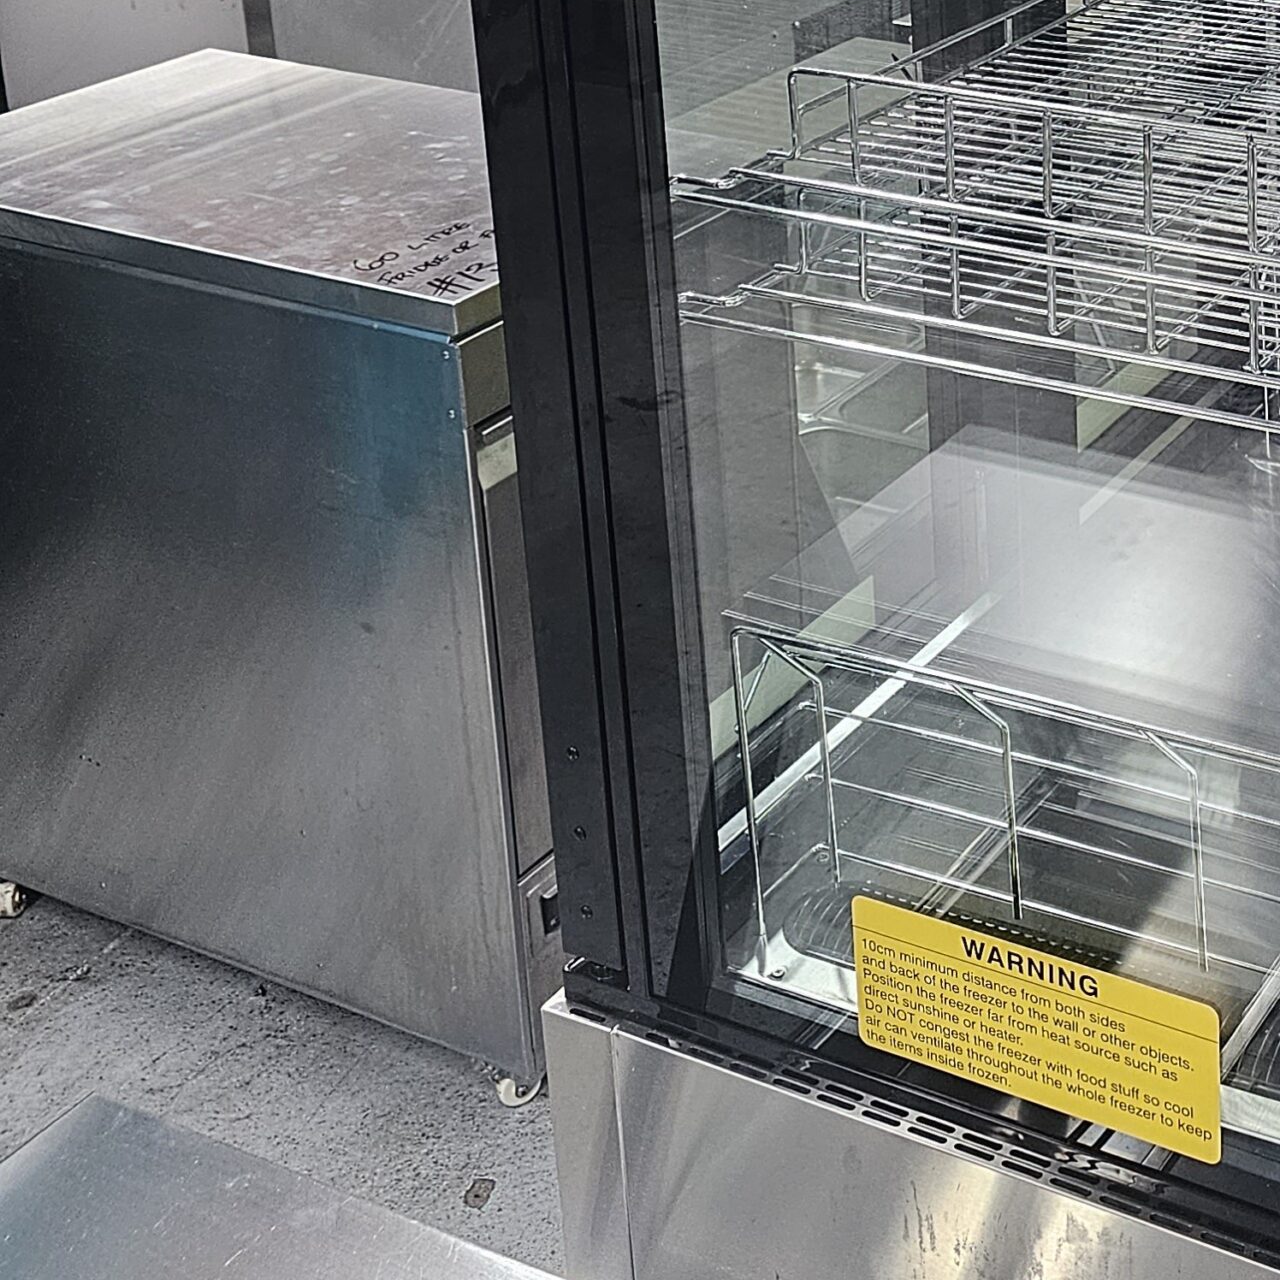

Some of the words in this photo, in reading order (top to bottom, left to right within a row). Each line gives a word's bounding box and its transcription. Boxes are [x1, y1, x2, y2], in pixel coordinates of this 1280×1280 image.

[862, 938, 896, 958] 10cm
[899, 951, 959, 978] minimum
[962, 971, 1017, 997] distance
[1021, 988, 1051, 1008] from
[1055, 999, 1085, 1019] both
[1090, 1013, 1126, 1033] sides
[862, 954, 886, 970] and
[890, 961, 920, 981] back
[923, 974, 936, 986] of
[940, 978, 960, 994] the
[963, 986, 1008, 1009] freezer
[1012, 1001, 1024, 1015] to
[1028, 1007, 1049, 1023] the
[1053, 1016, 1079, 1033] wall
[1082, 1026, 1096, 1038] or
[1100, 1031, 1137, 1051] other
[1139, 1044, 1195, 1072] objects.
[864, 985, 899, 1004] direct
[902, 998, 960, 1025] sunshine
[963, 1018, 976, 1030] or
[980, 1022, 1024, 1046] heater.
[961, 936, 1098, 998] WARNING
[863, 968, 913, 994] Position
[916, 986, 936, 1002] the
[940, 993, 983, 1016] freezer
[988, 1008, 1004, 1023] far
[1008, 1015, 1038, 1035] from
[1041, 1025, 1071, 1046] heat
[1074, 1039, 1121, 1062] source
[1124, 1055, 1157, 1076] such
[1161, 1068, 1179, 1082] as
[865, 999, 883, 1013] Do
[887, 1006, 915, 1024] NOT
[919, 1018, 970, 1043] congest
[974, 1034, 994, 1051] the
[997, 1042, 1042, 1066] freezer
[1046, 1060, 1073, 1078] with
[1077, 1068, 1107, 1089] food
[1111, 1082, 1140, 1100] stuff
[1143, 1093, 1160, 1107] so
[1164, 1100, 1194, 1119] cool
[866, 1029, 886, 1044] the
[889, 1035, 923, 1057] items
[927, 1048, 964, 1070] inside
[968, 1063, 1012, 1087] frozen.
[865, 1015, 881, 1028] air
[885, 1023, 907, 1037] can
[911, 1029, 963, 1055] ventilate
[966, 1047, 1038, 1081] throughout
[1042, 1073, 1062, 1089] the
[1066, 1081, 1106, 1104] whole
[1110, 1095, 1157, 1121] freezer
[1160, 1112, 1174, 1127] to
[1177, 1119, 1213, 1142] keep
